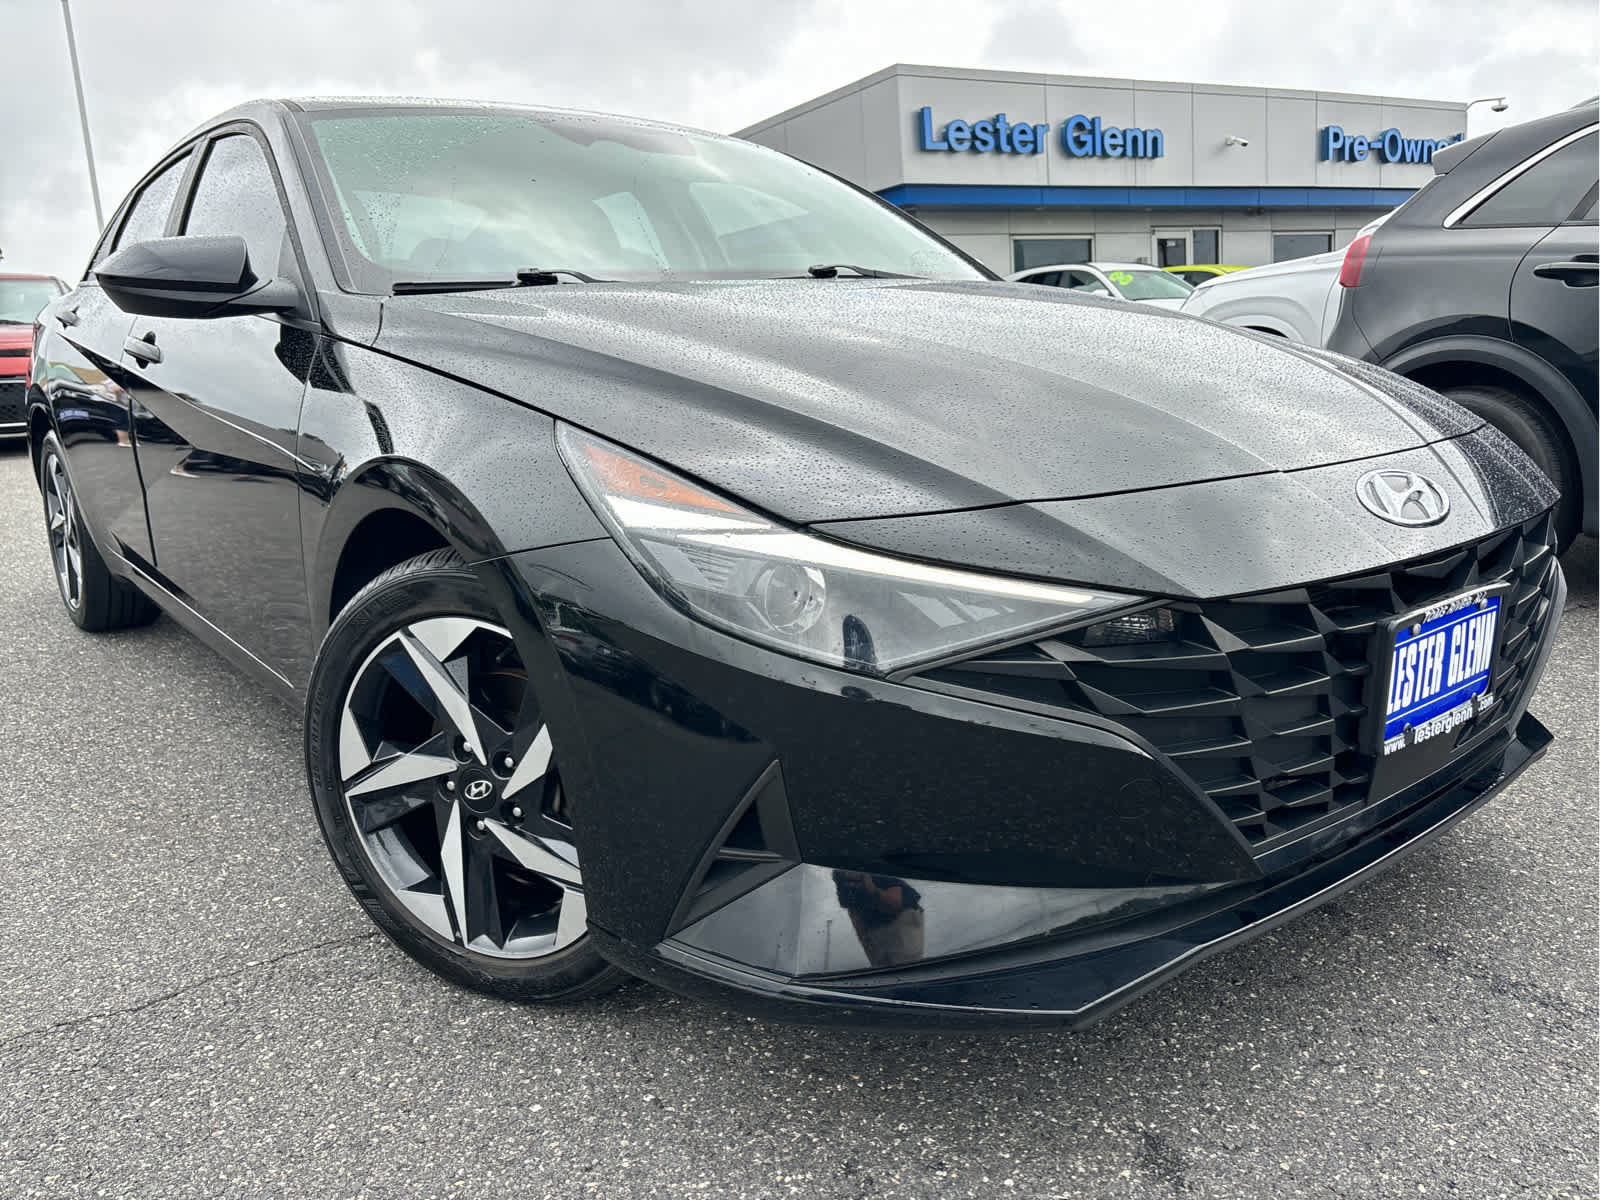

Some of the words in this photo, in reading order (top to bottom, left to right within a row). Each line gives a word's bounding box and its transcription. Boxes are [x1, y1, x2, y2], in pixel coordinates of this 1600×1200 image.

[919, 107, 1049, 155] Lester
[1062, 114, 1164, 159] Glenn
[1323, 125, 1465, 164] Pre-Own
[1387, 631, 1446, 716] LESTER
[1447, 611, 1497, 687] GLENN
